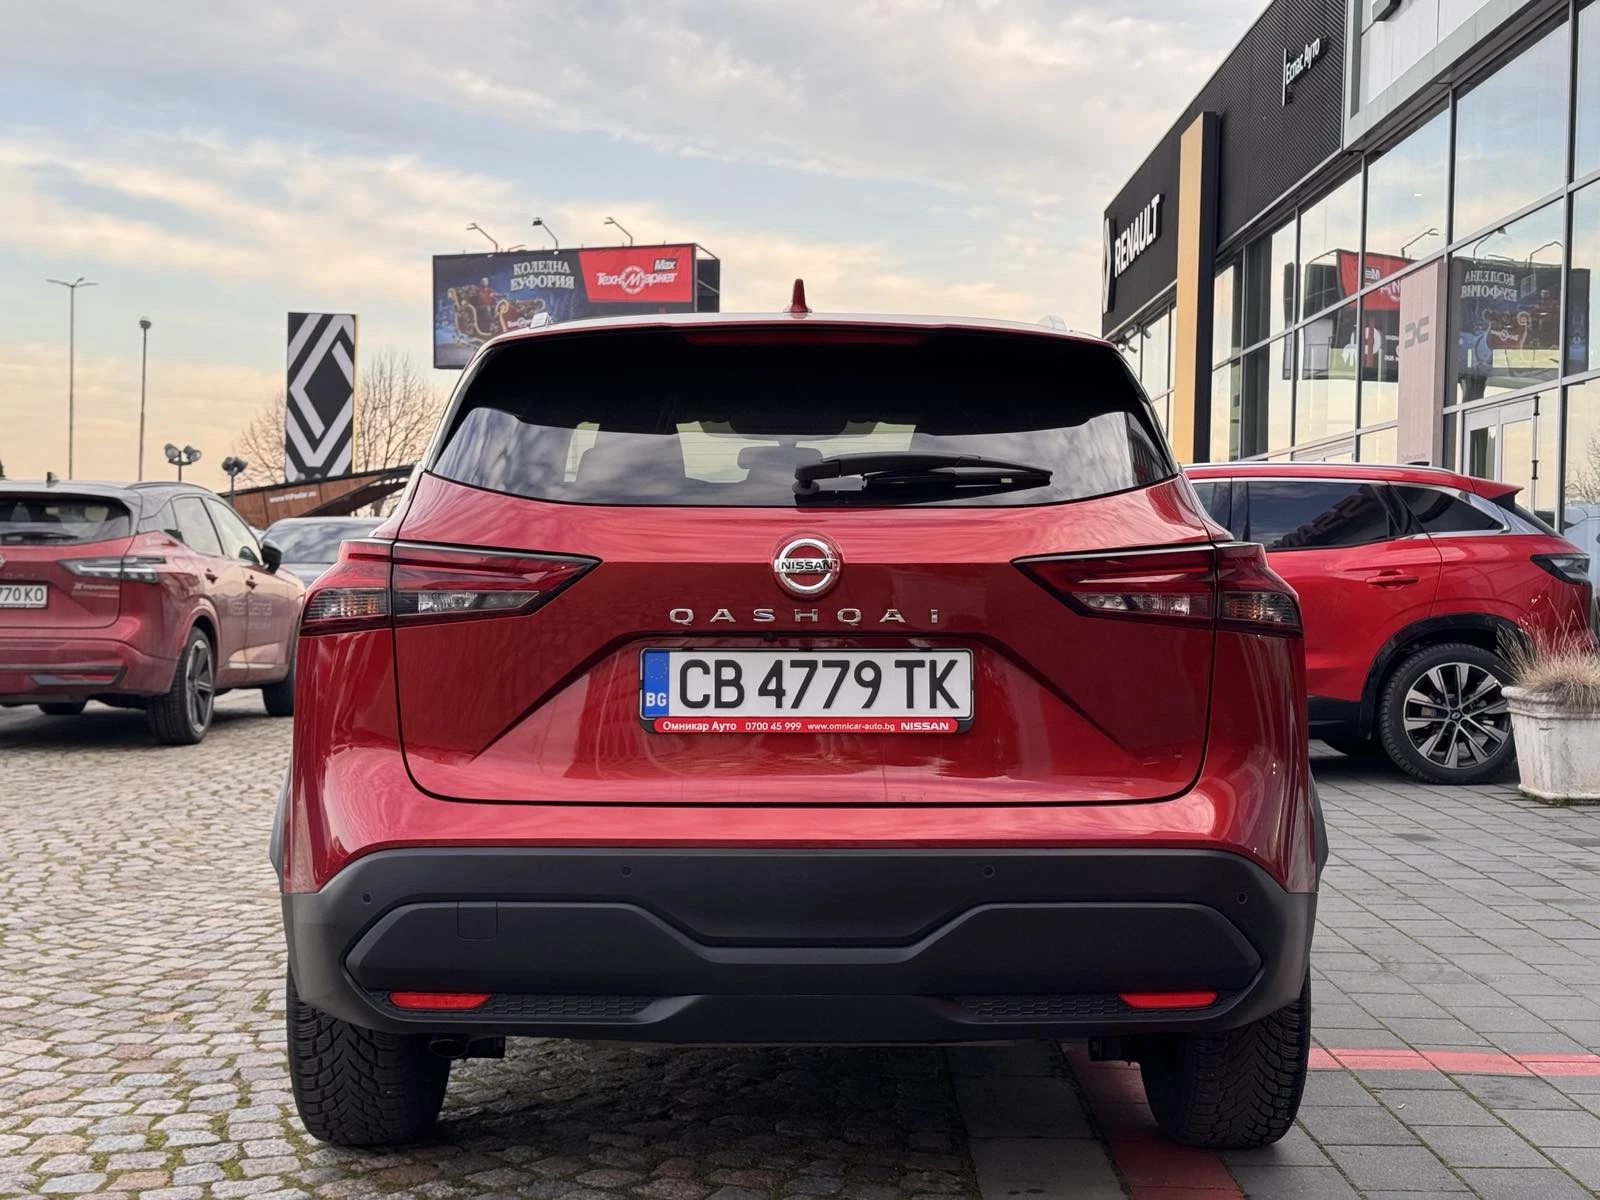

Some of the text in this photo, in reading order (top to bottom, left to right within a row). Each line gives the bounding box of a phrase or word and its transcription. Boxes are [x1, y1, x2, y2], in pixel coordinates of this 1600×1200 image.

[1115, 193, 1160, 278] RENAULT
[513, 260, 571, 276] КОЛЕДНА
[781, 561, 833, 570] NISSAN
[24, 587, 44, 602] KO
[679, 659, 960, 709] CB 4779 TK
[646, 692, 667, 707] BG
[662, 721, 737, 732] Омникар Ауто
[745, 722, 802, 731] 0700 45 999
[807, 722, 895, 732] www.omnicar-auto.bg
[900, 722, 949, 731] NISSAN
